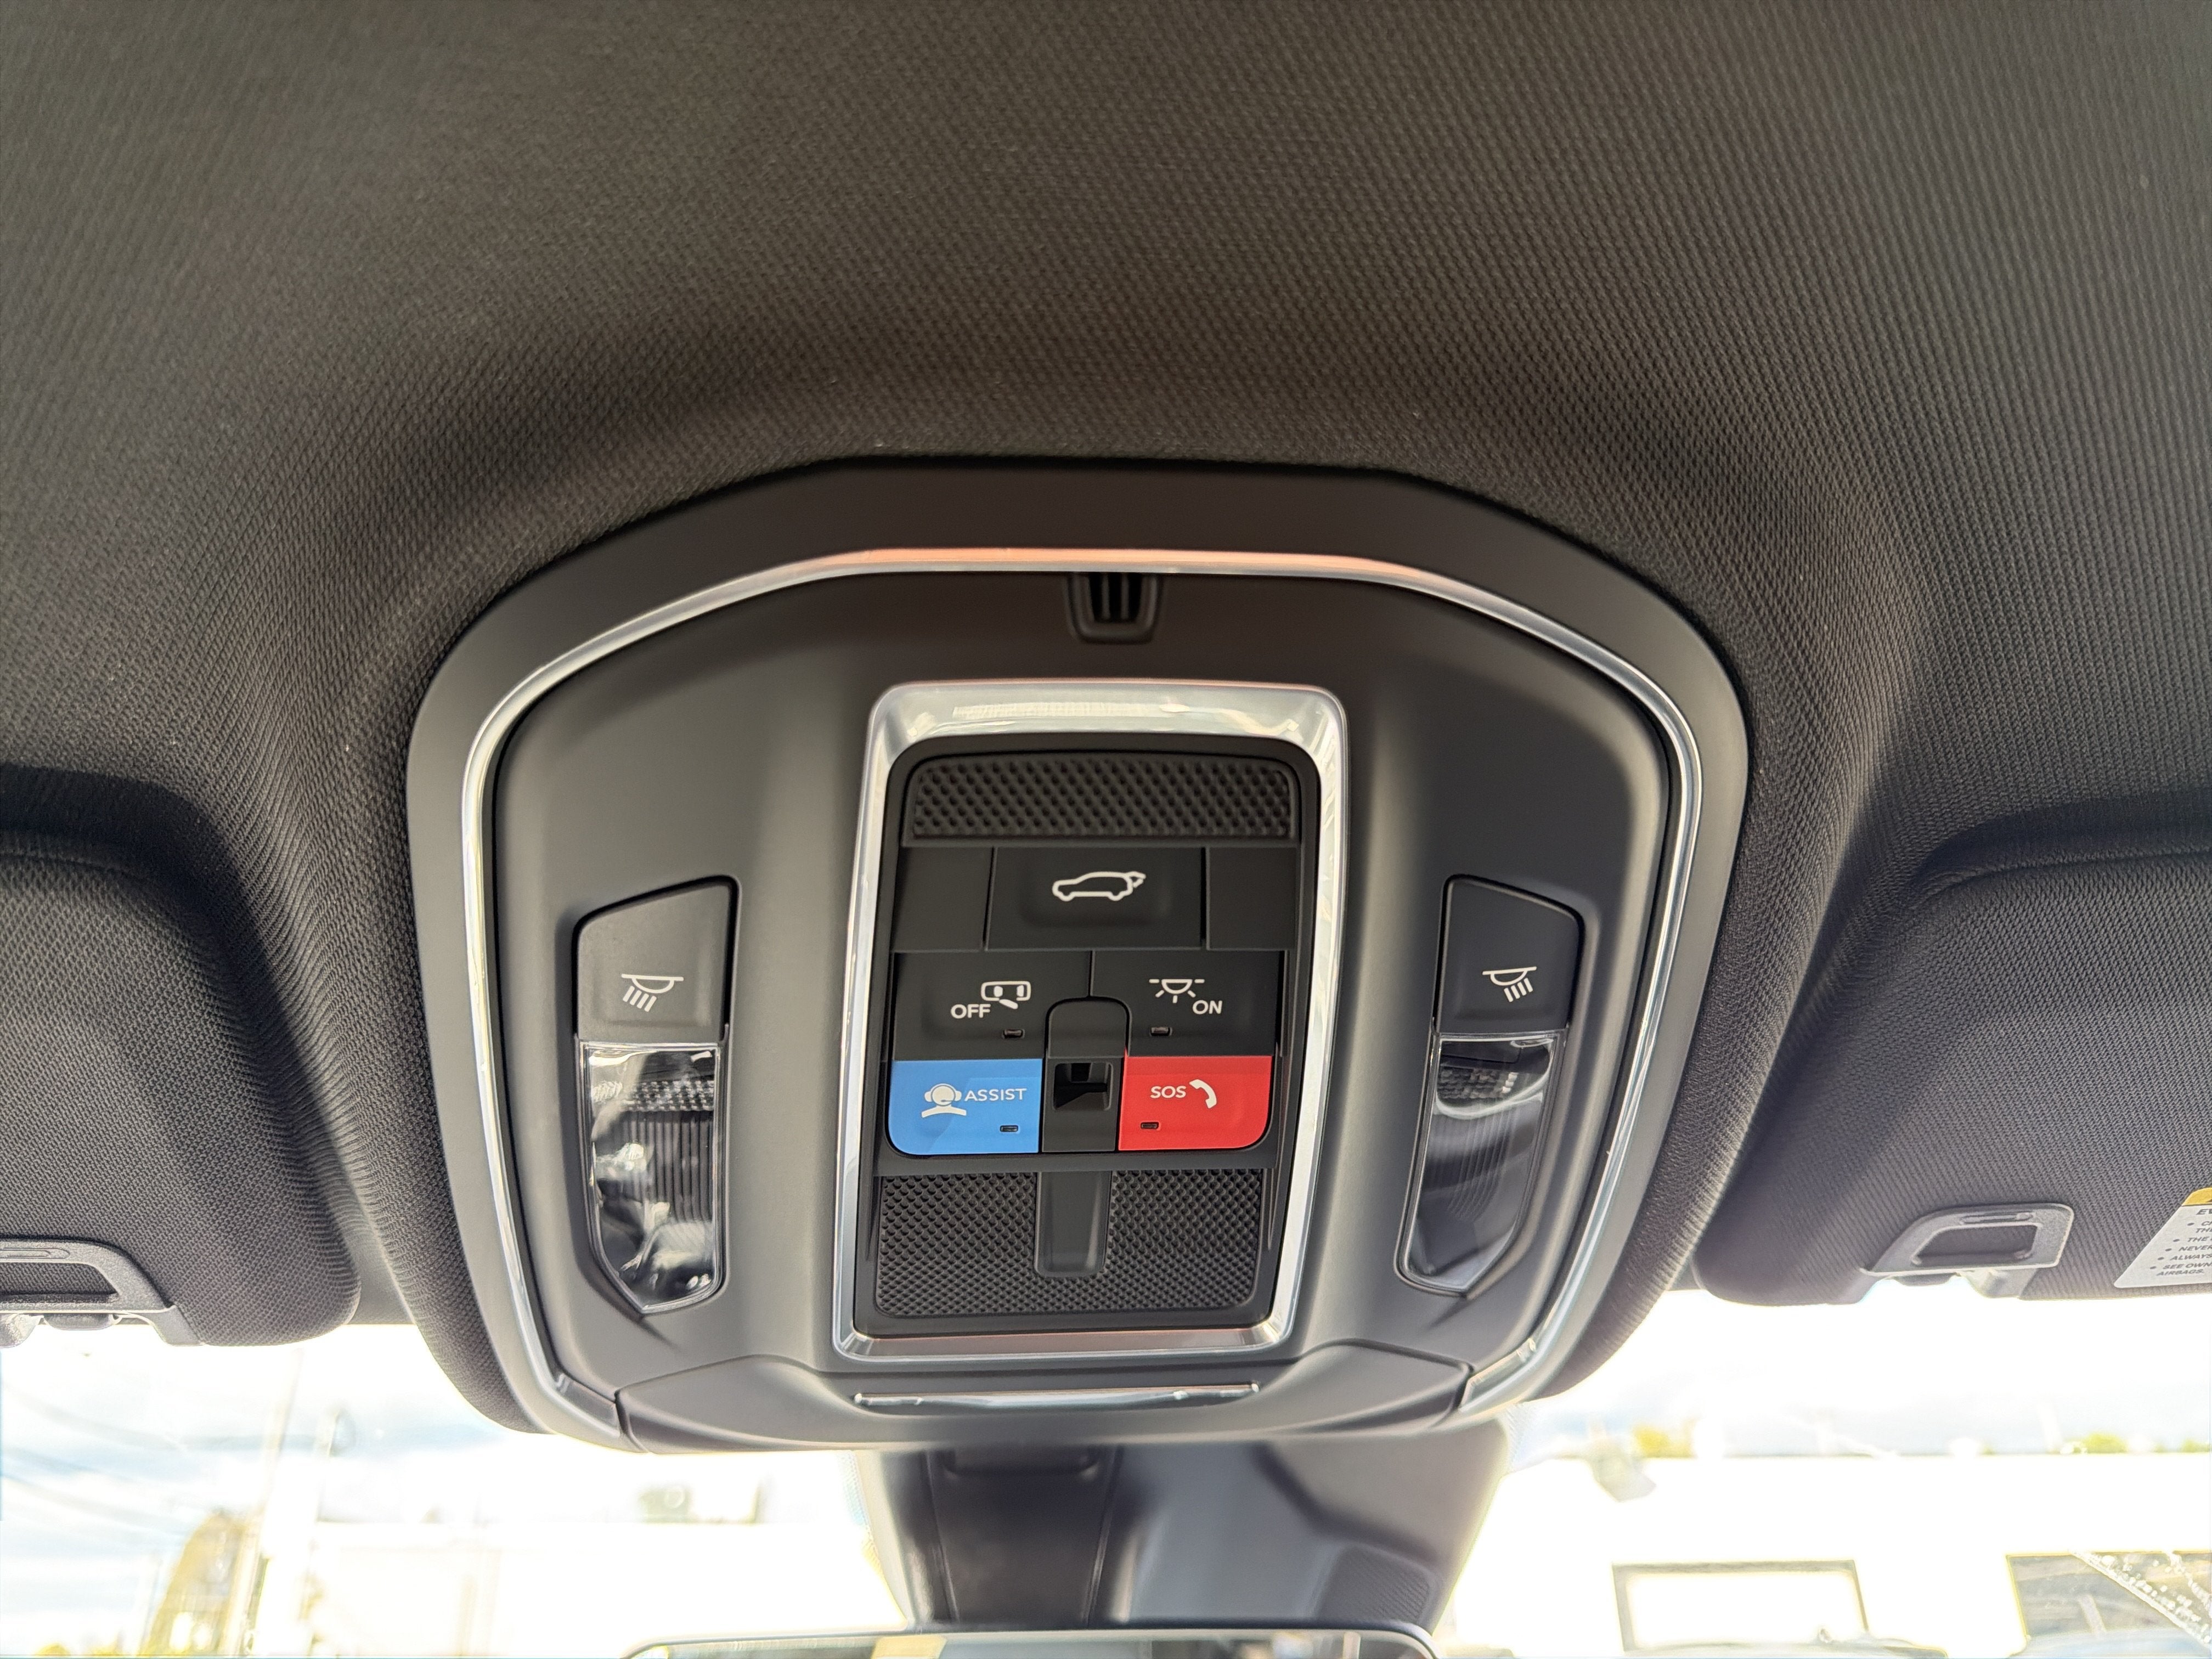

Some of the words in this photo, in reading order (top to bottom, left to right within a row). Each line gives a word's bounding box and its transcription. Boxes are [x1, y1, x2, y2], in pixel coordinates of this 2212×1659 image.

[951, 1004, 991, 1019] OFF
[1193, 1000, 1222, 1014] ON
[964, 1088, 1027, 1101] ASSIST
[1150, 1086, 1186, 1098] SOS
